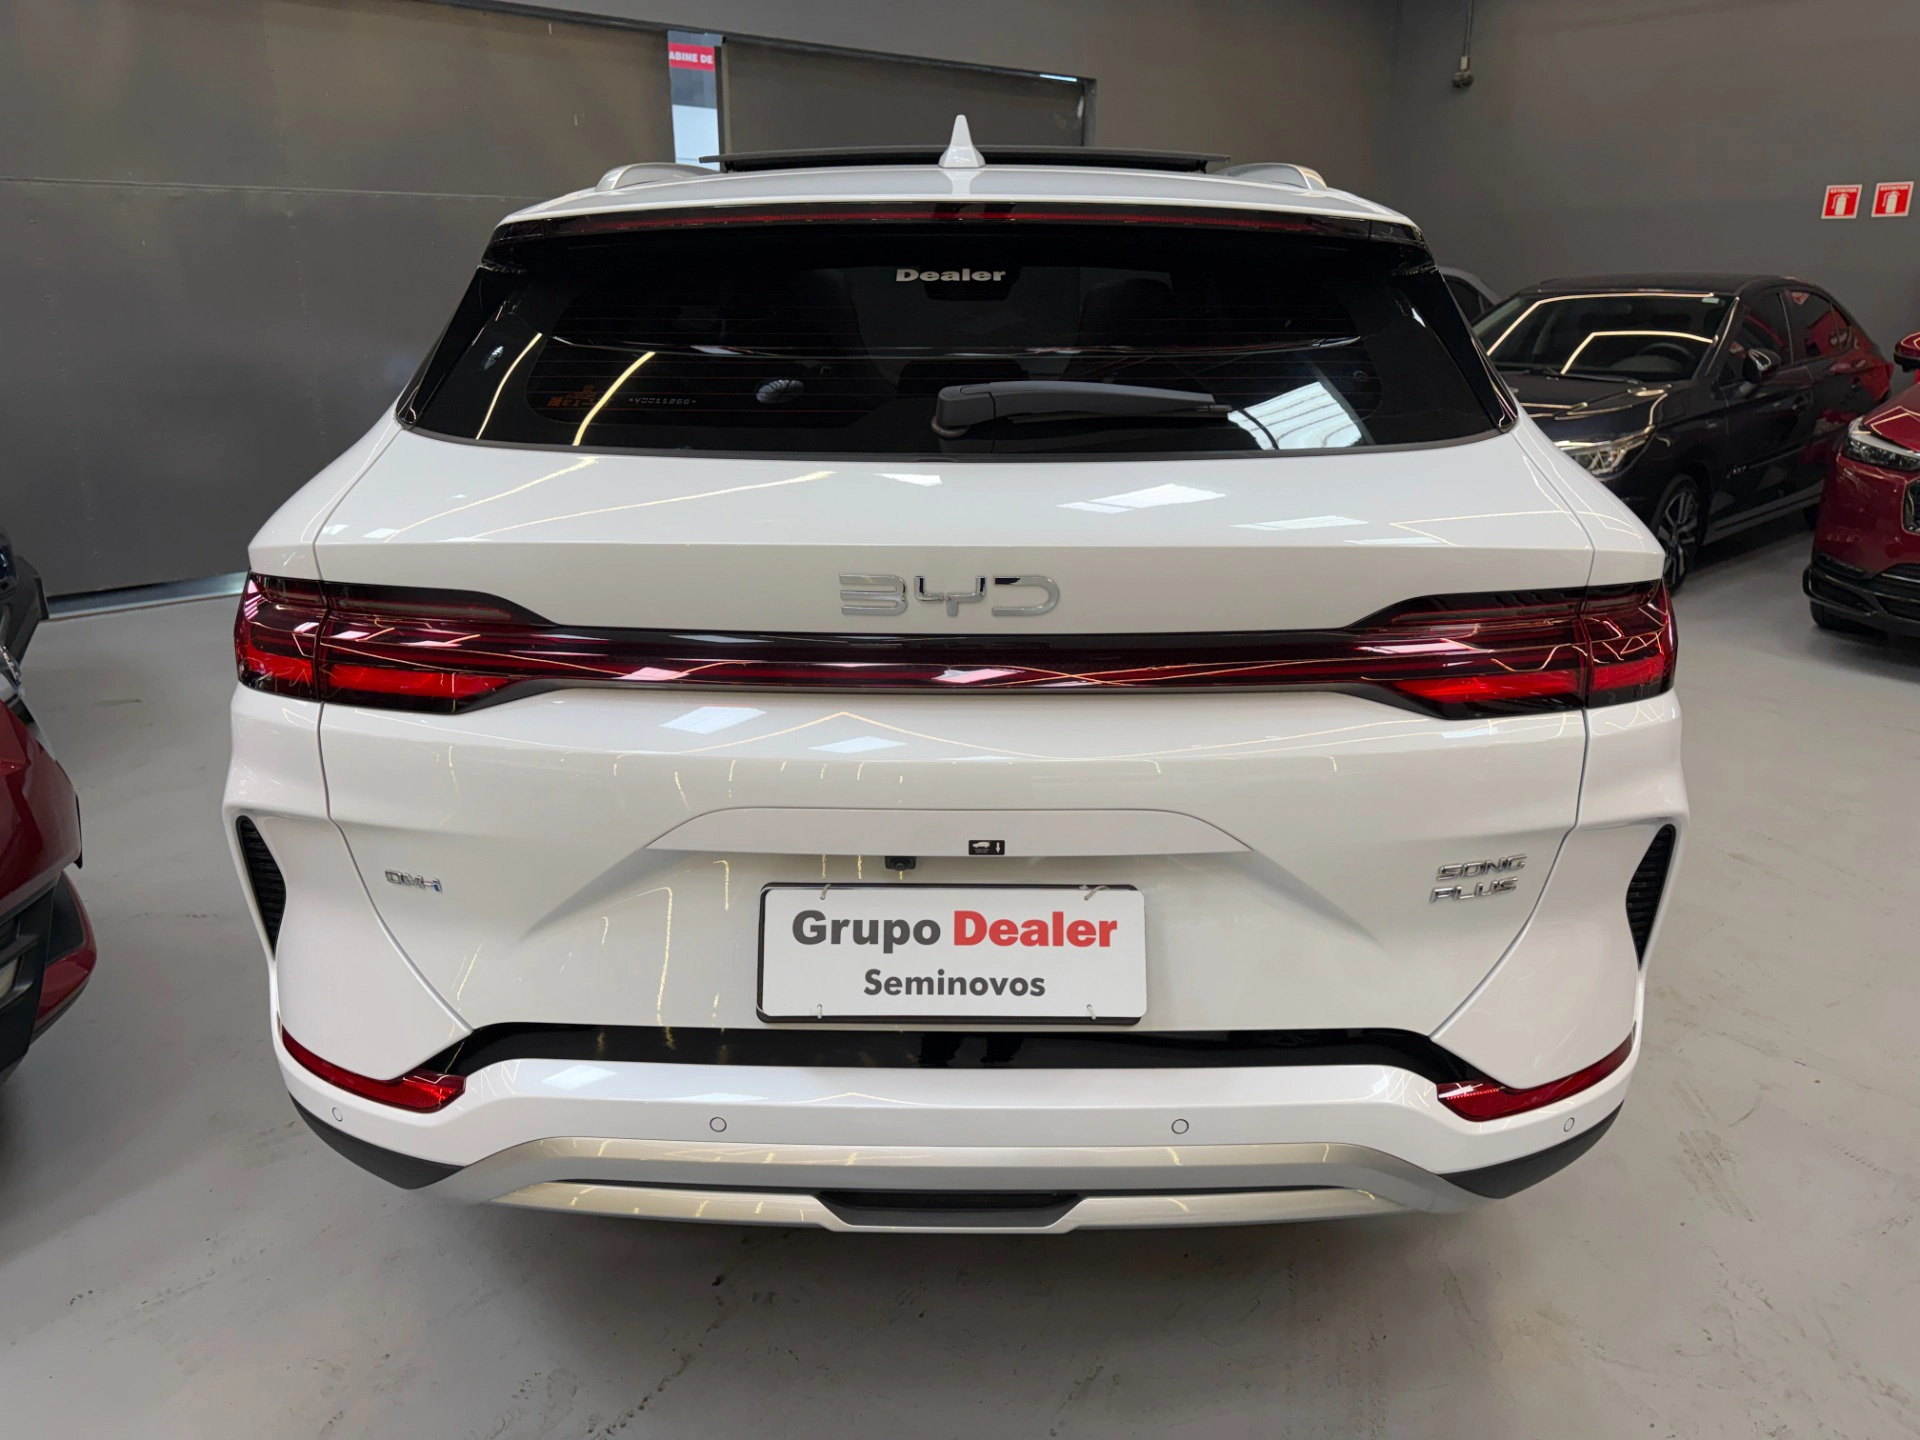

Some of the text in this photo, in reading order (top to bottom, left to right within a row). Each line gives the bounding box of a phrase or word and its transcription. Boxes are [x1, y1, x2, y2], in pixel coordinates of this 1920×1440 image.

[700, 54, 713, 64] DE
[896, 268, 1006, 282] Dealer
[839, 573, 1060, 617] BYD
[1436, 853, 1527, 881] SONG
[1429, 877, 1519, 904] PLUS
[791, 909, 1118, 954] Grupo Dealer
[863, 968, 1046, 997] Seminovos
